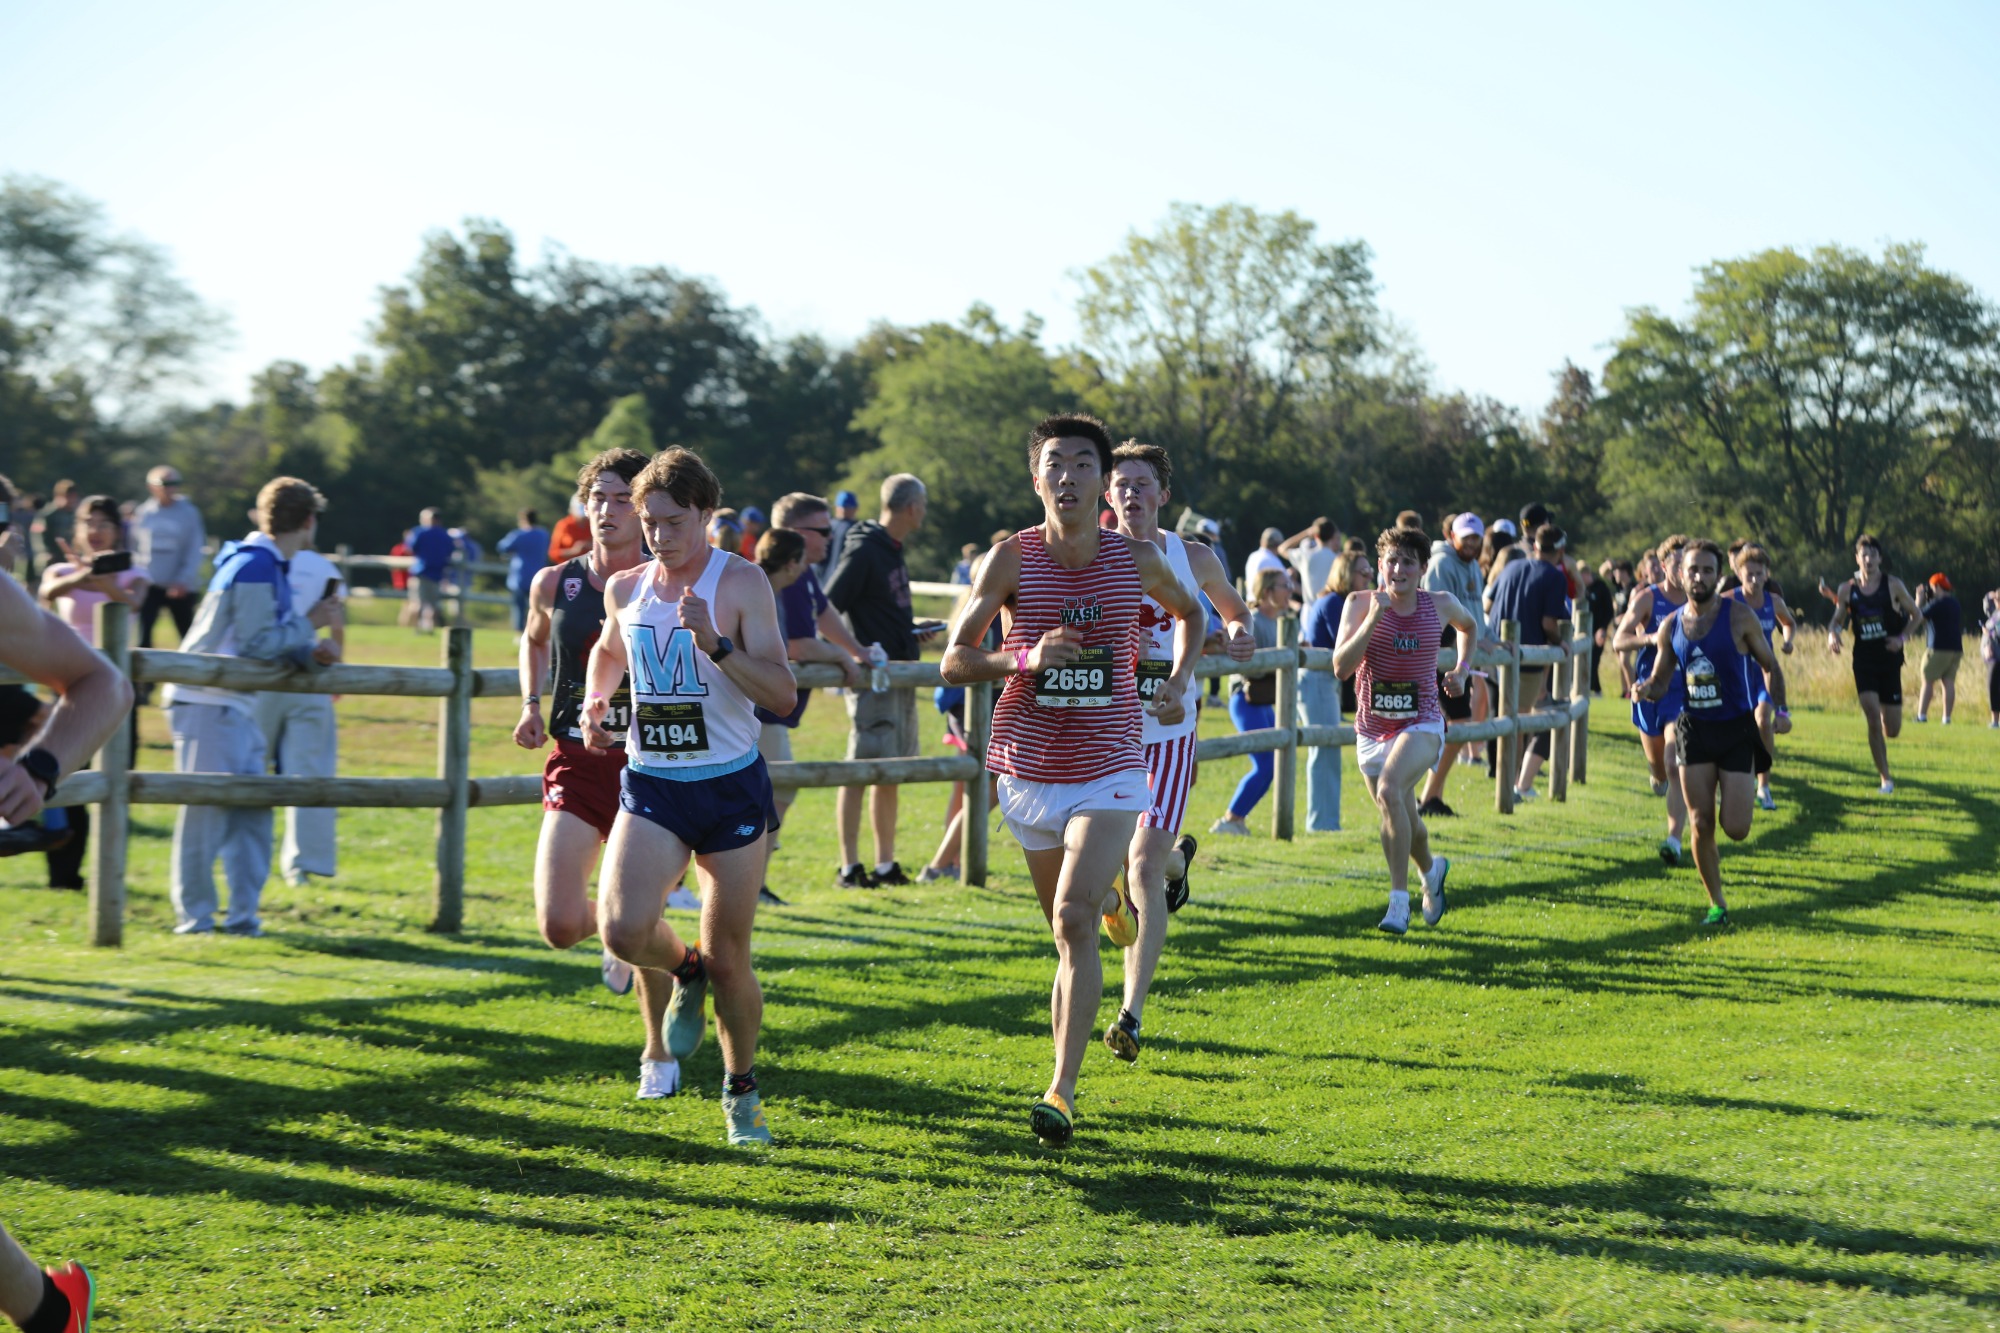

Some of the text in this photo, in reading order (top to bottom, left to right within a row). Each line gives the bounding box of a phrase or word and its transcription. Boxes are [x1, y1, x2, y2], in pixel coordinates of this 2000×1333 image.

[1059, 604, 1103, 625] WASH
[1393, 638, 1420, 649] WASH
[627, 624, 709, 696] M
[1044, 668, 1104, 690] 2659
[1374, 694, 1412, 709] 2662
[643, 724, 699, 746] 2194
